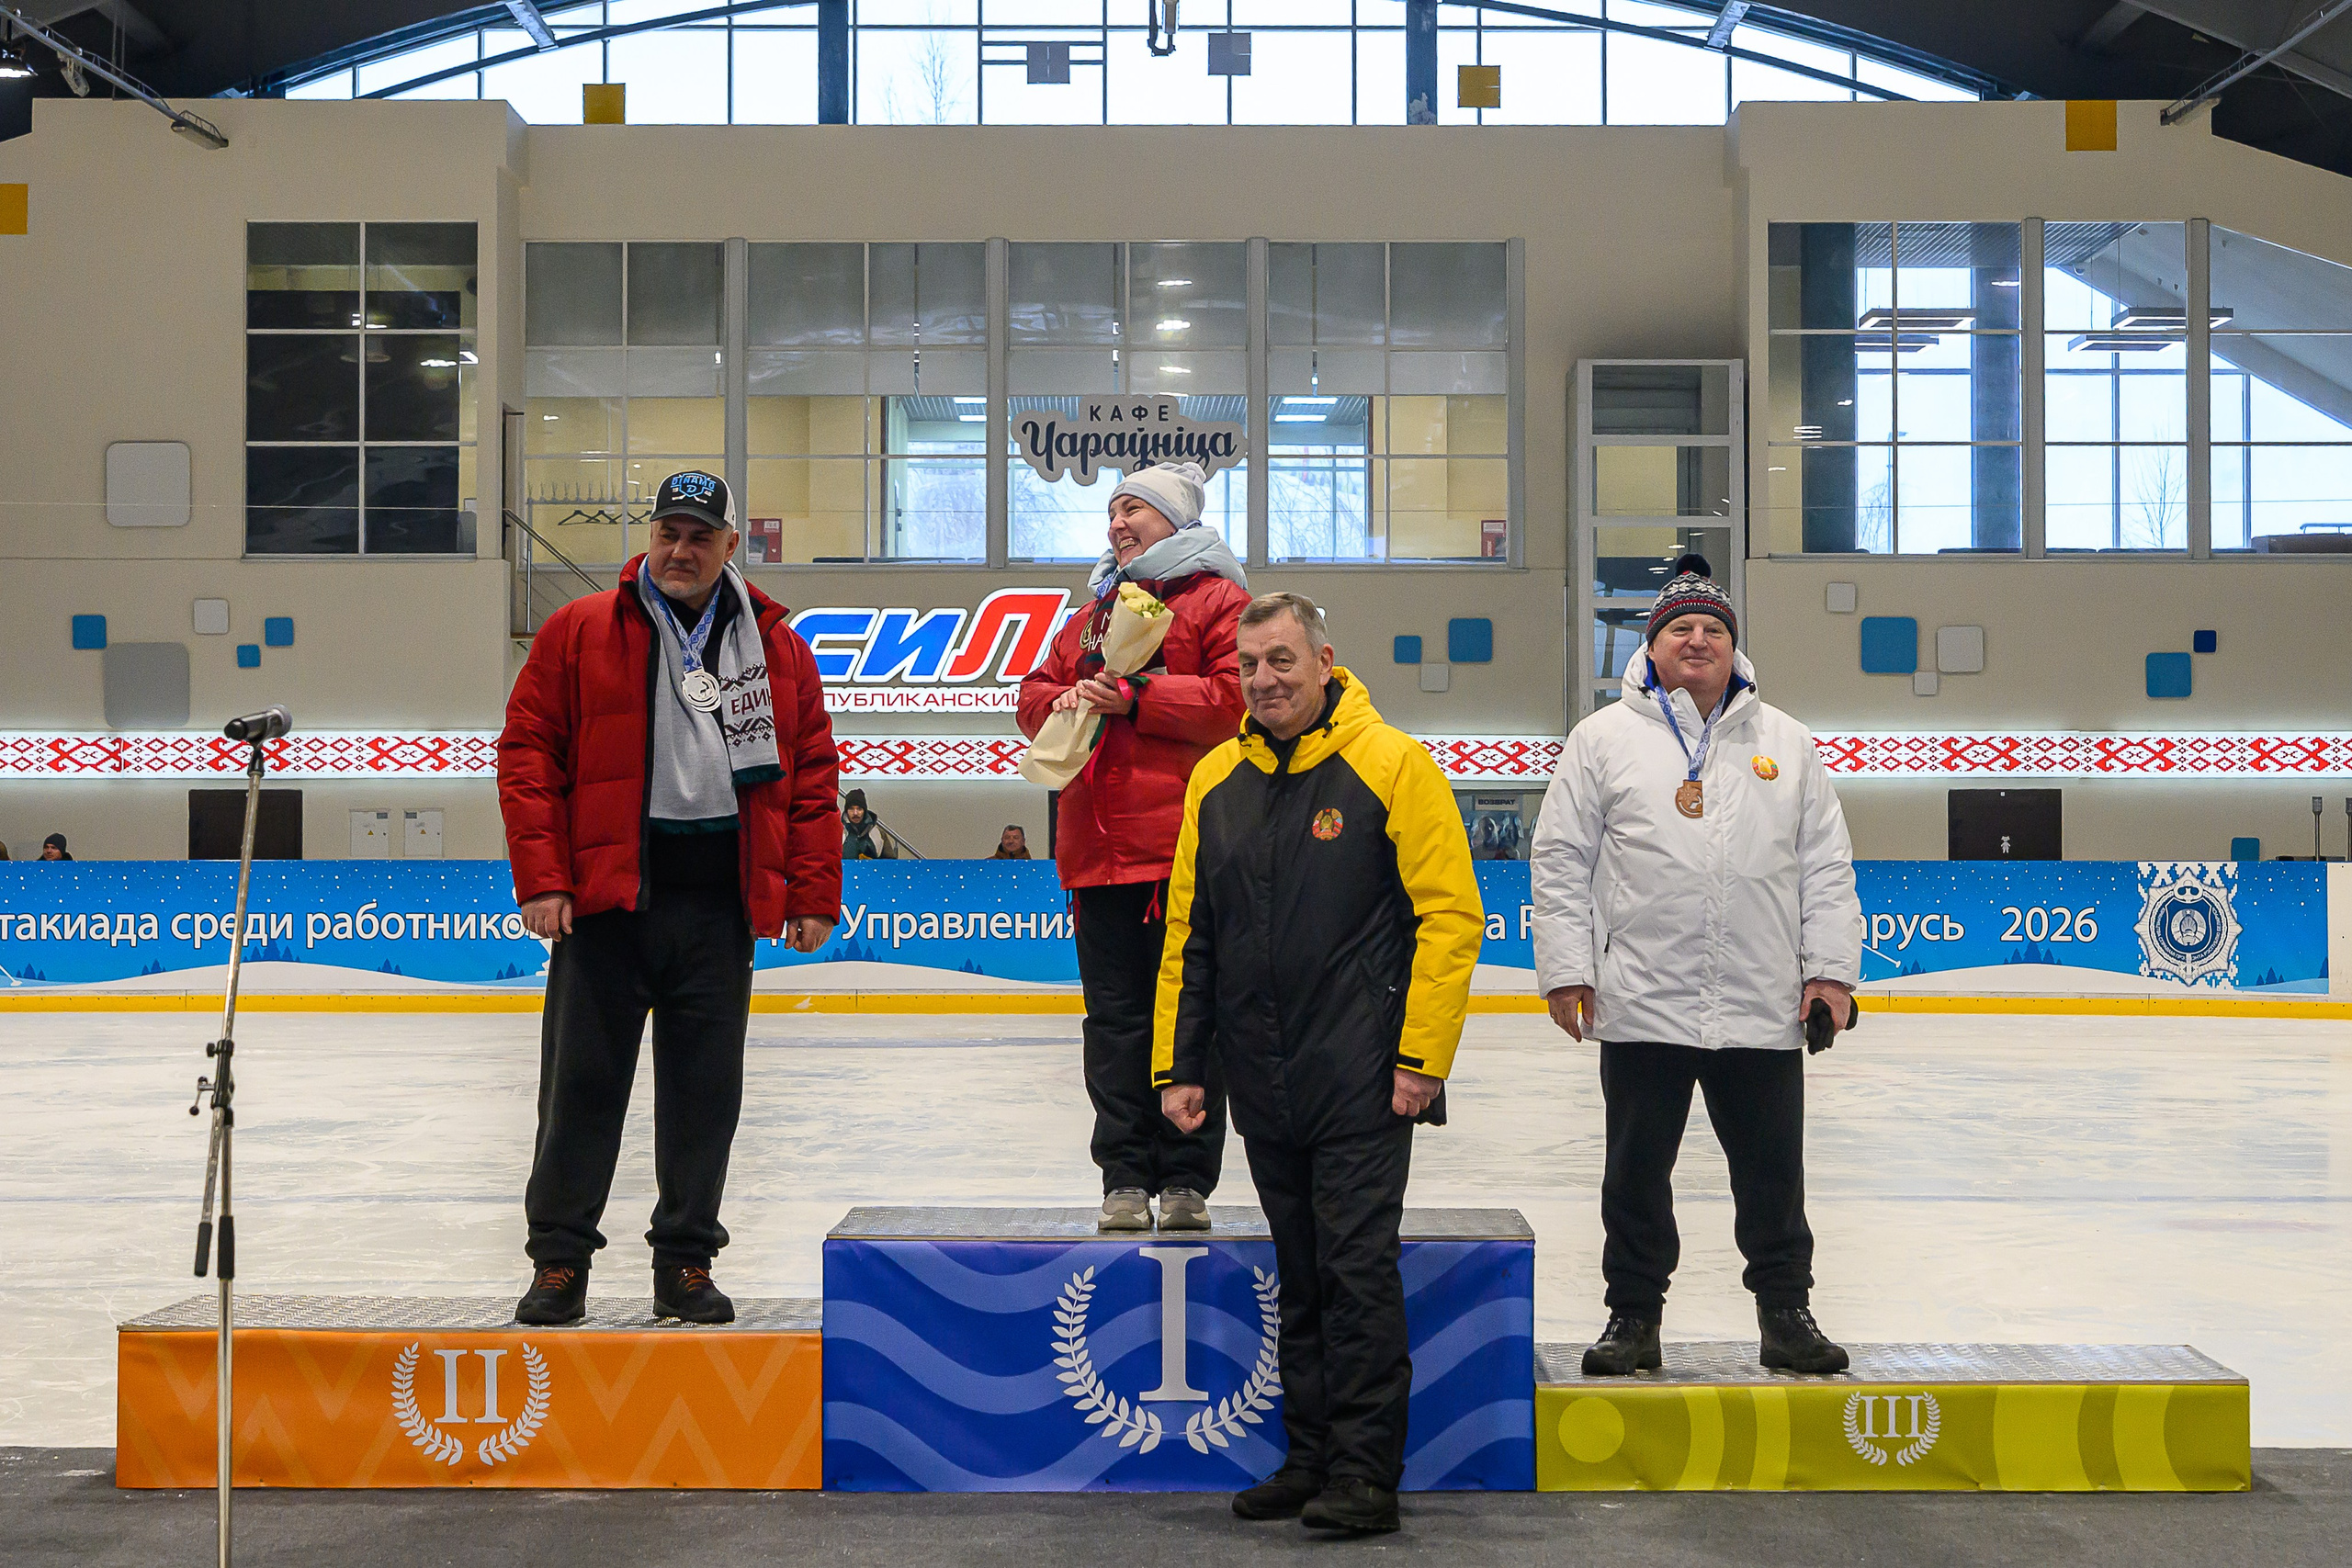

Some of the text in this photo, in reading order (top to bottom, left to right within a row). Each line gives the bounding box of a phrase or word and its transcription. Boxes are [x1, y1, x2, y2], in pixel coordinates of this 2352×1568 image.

[1089, 405, 1170, 422] КАФЕ
[672, 477, 715, 490] DINAMO
[170, 912, 293, 949] среди
[306, 901, 544, 949] работнико
[1999, 905, 2099, 943] 2026
[1138, 1247, 1209, 1401] I
[433, 1348, 508, 1424] II
[1860, 1395, 1924, 1438] III
